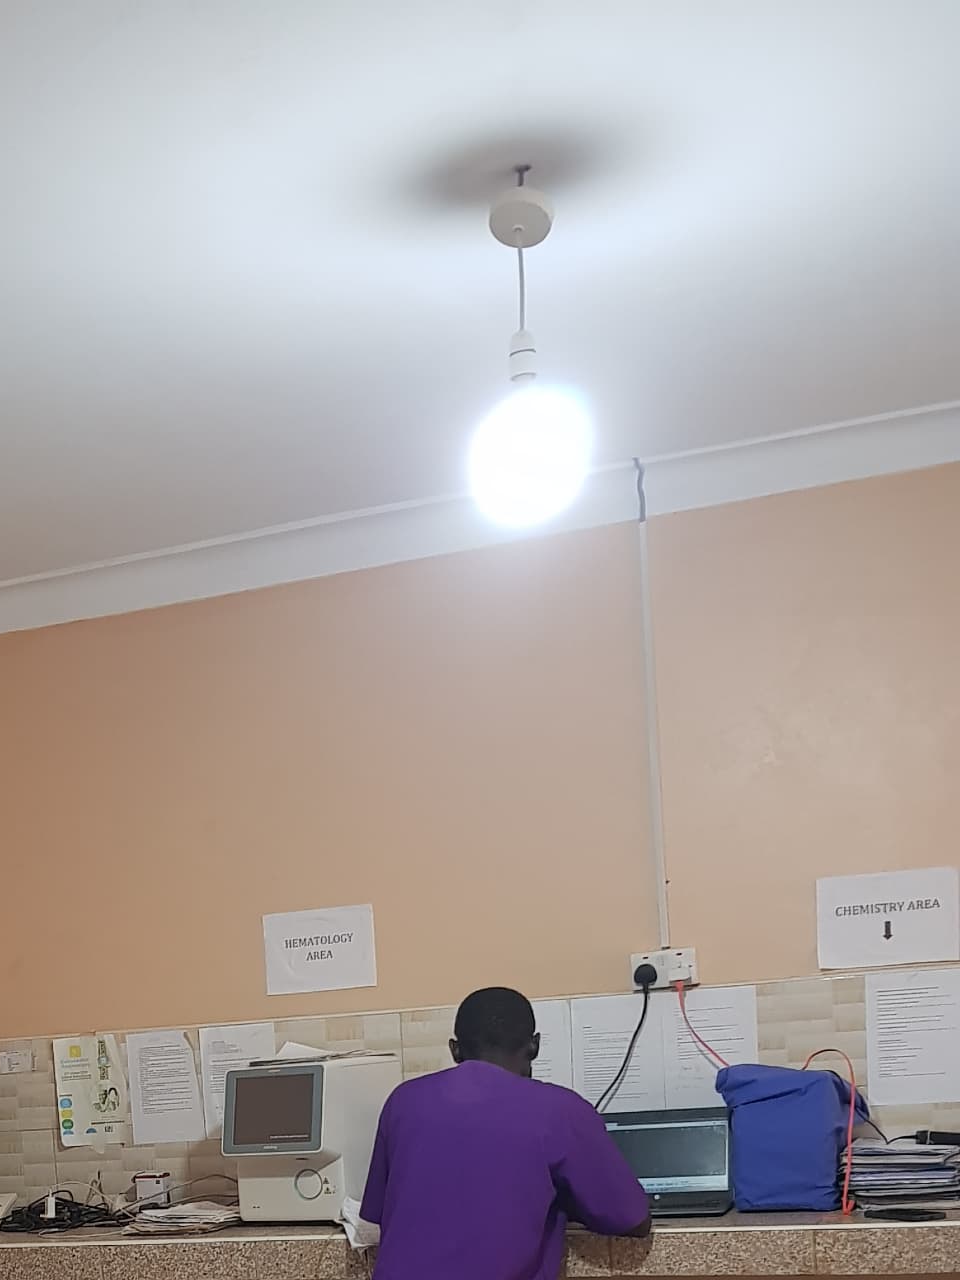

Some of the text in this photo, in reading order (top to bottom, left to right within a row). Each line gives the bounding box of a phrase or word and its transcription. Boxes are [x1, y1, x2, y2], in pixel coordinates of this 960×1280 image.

[835, 898, 941, 917] CHEMISTRY AREA
[284, 932, 354, 949] HEMATOLOGY
[306, 949, 334, 961] AREA
